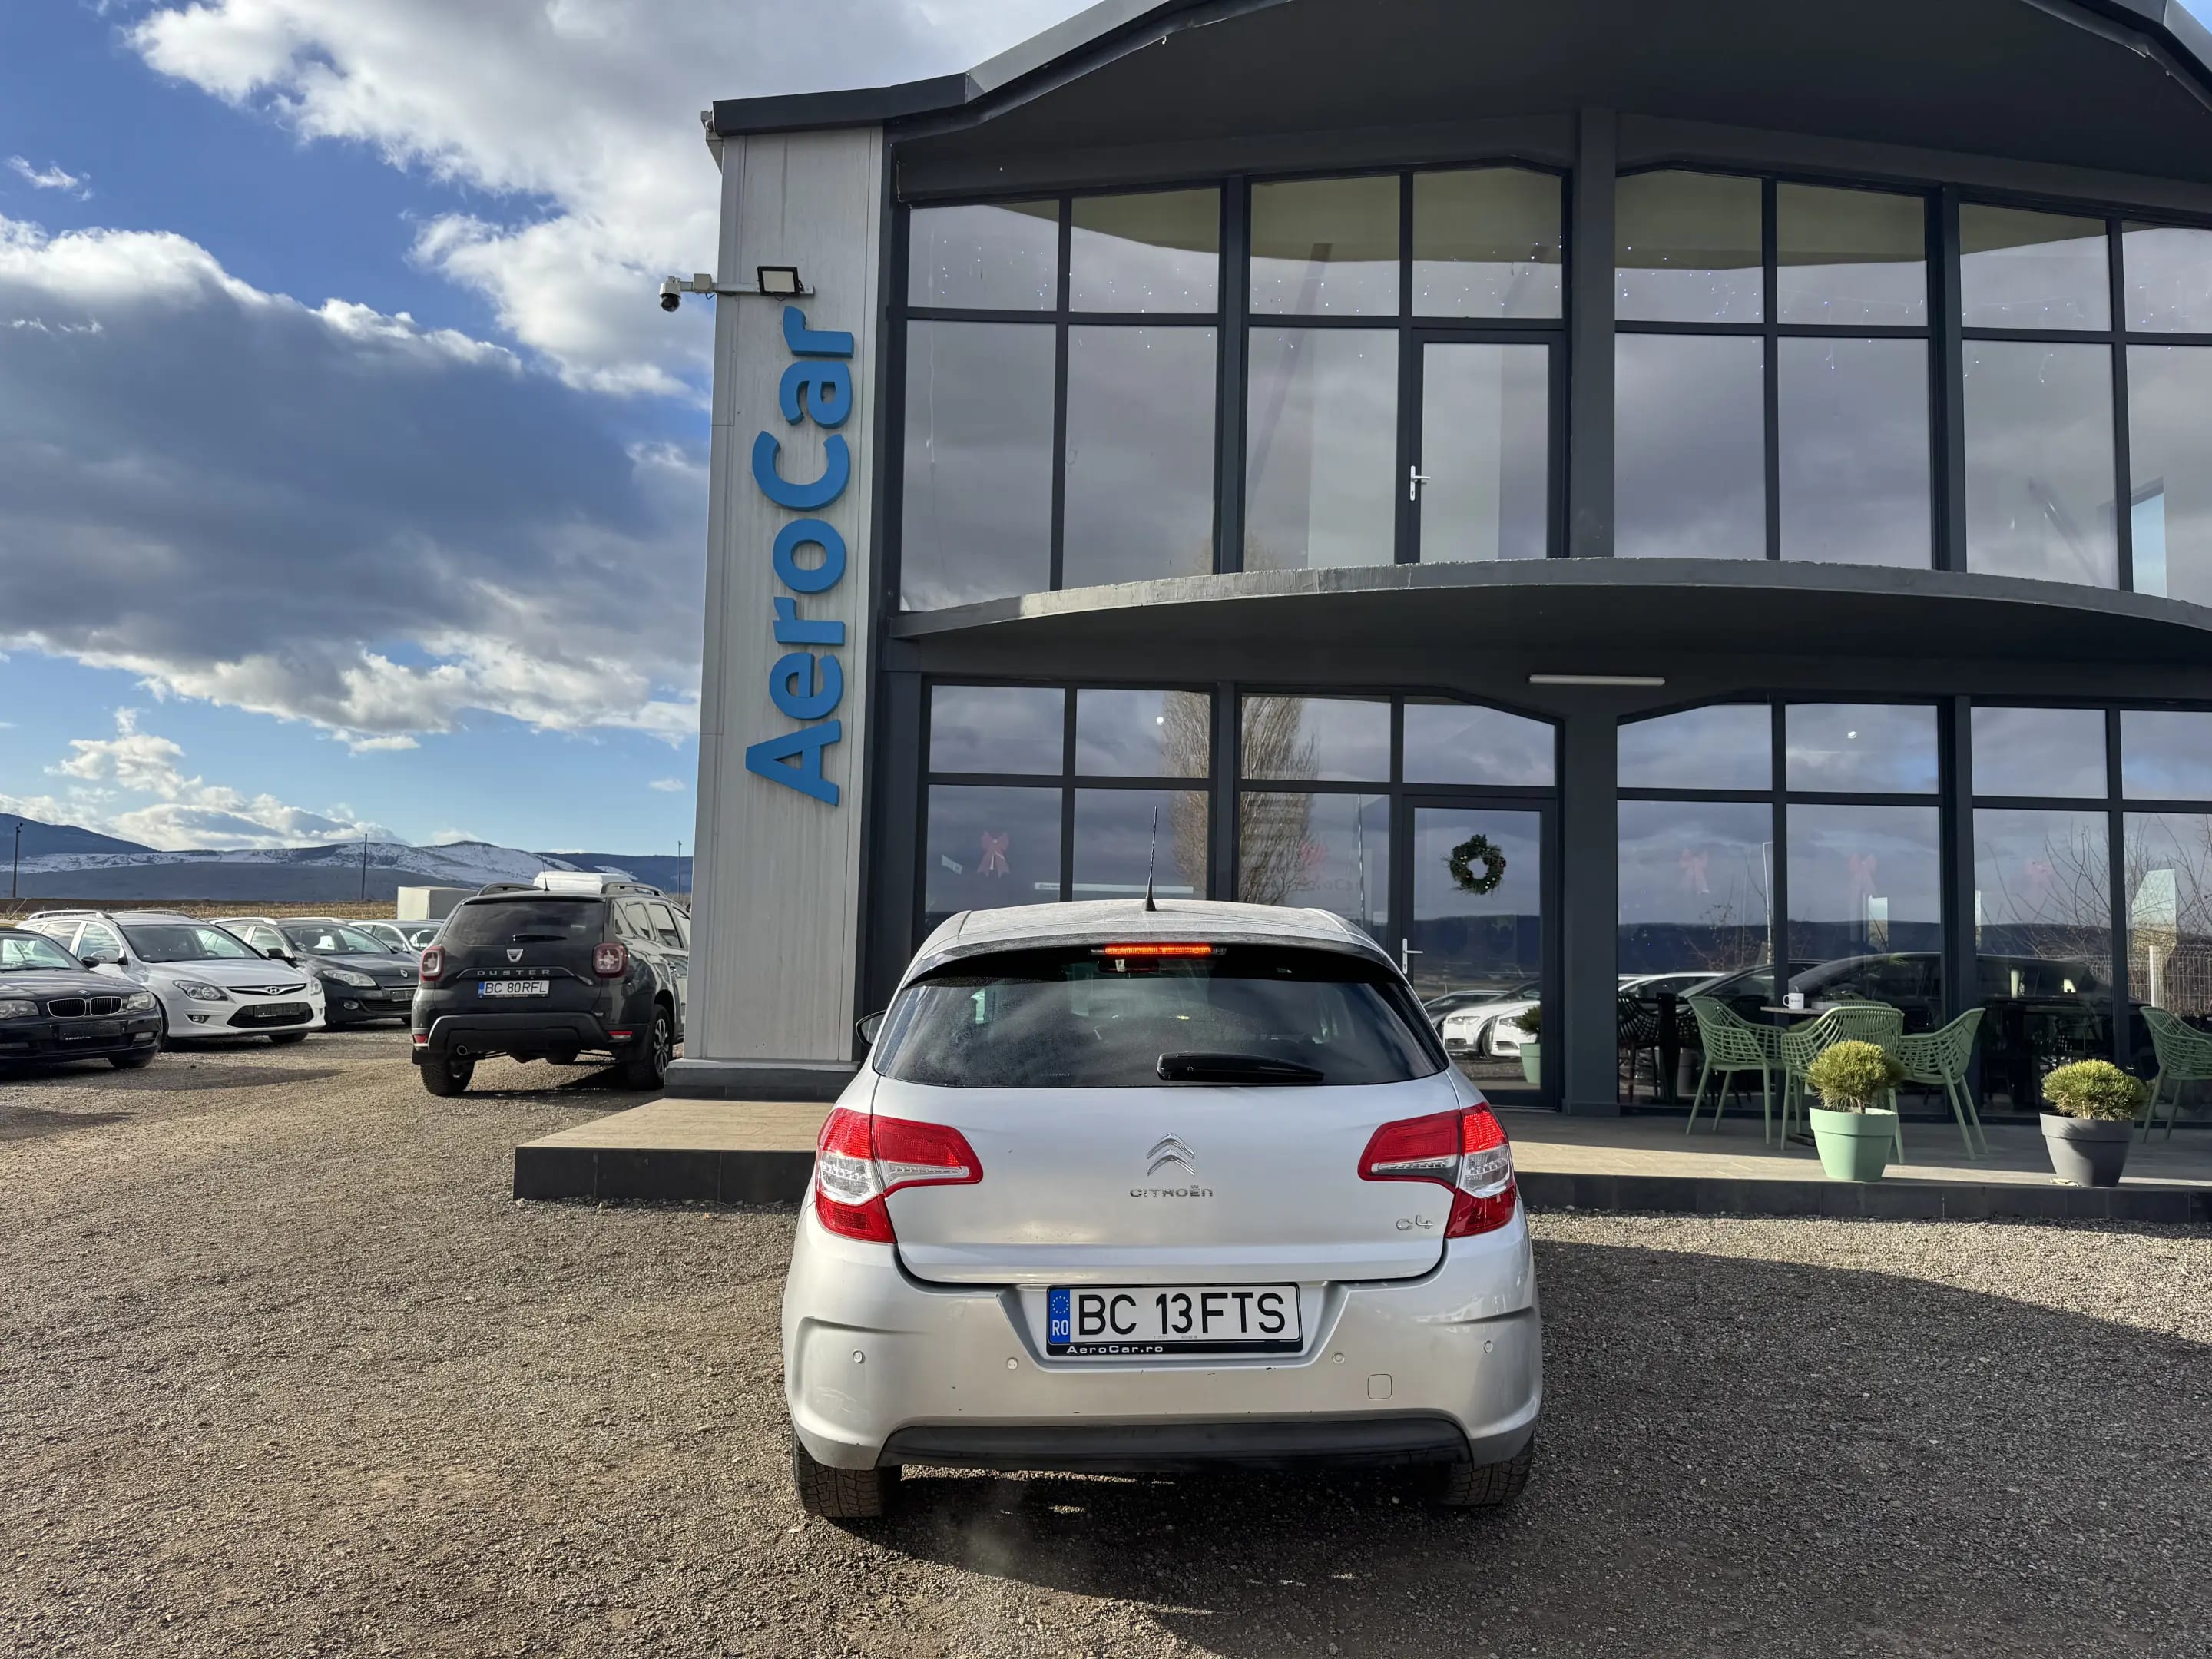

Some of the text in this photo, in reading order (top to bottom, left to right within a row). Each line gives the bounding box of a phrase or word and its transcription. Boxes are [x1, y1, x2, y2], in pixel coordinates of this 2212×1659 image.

[745, 306, 854, 806] AeroCar
[485, 982, 546, 994] BC 80RFL
[1078, 1292, 1286, 1336] BC 13FTS
[1051, 1319, 1069, 1336] RO
[1066, 1345, 1164, 1355] AeroCar.ro
